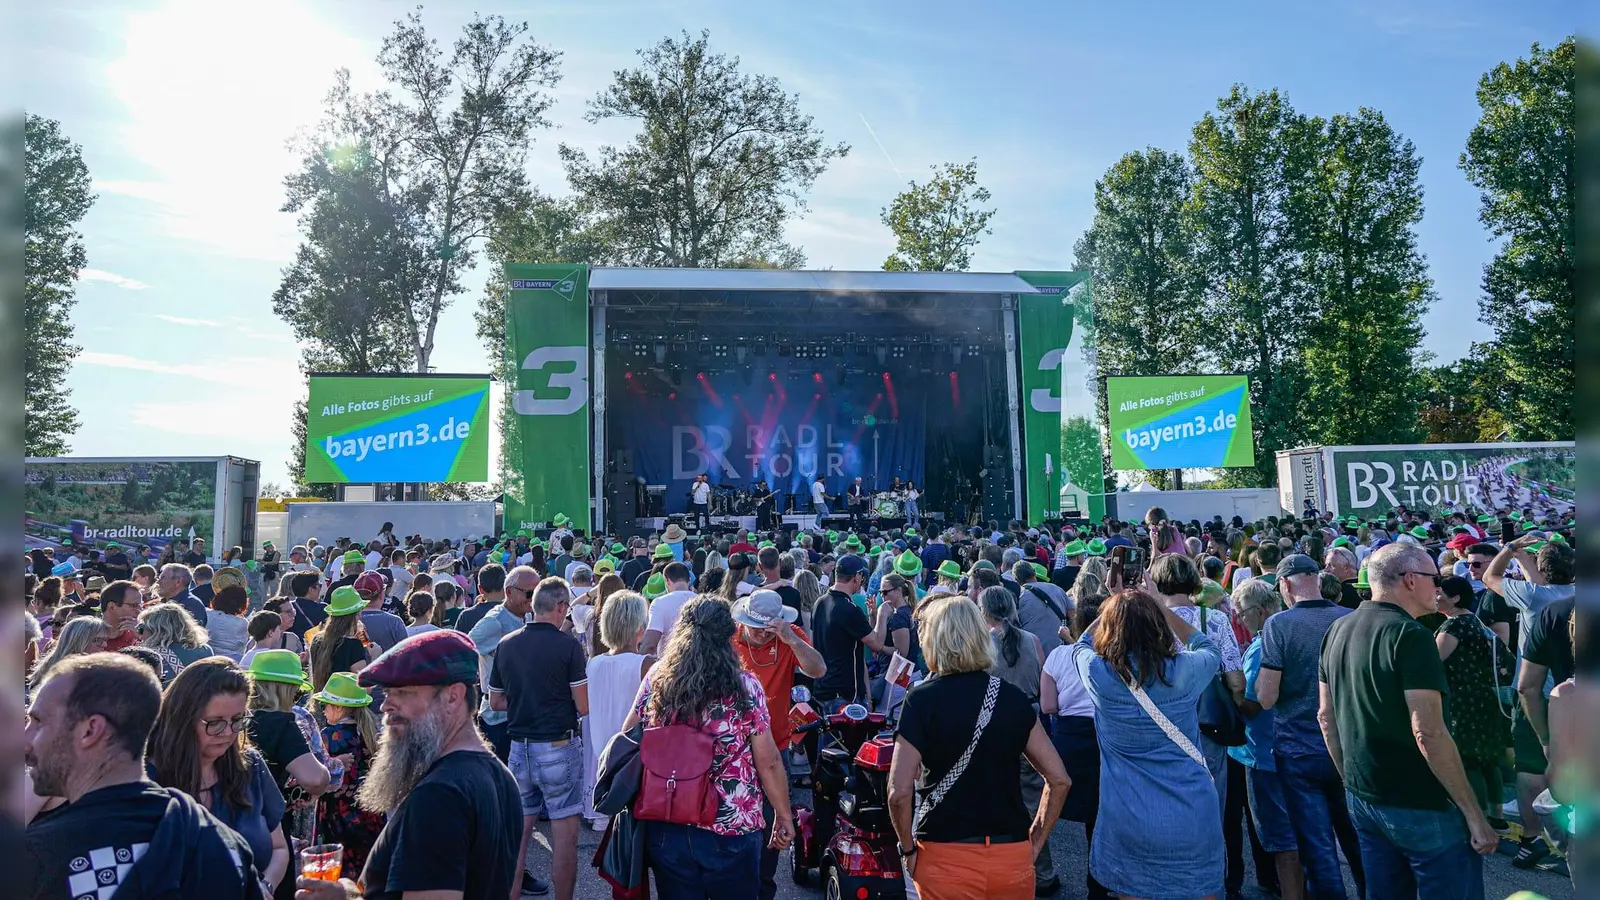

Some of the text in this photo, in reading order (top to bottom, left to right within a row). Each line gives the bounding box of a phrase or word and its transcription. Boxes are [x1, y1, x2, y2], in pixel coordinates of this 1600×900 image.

[560, 280, 575, 292] 3
[512, 346, 589, 415] 3
[321, 405, 345, 417] Alle
[347, 400, 380, 413] Fotos
[382, 392, 411, 410] gibts
[413, 389, 434, 403] auf
[1119, 401, 1138, 412] Alle
[1139, 396, 1165, 407] Fotos
[1165, 389, 1188, 406] gibts
[1190, 386, 1206, 398] auf
[325, 417, 470, 461] bayern3.de
[746, 424, 844, 448] RADL
[1125, 409, 1237, 451] bayern3.de
[672, 424, 741, 480] BR
[745, 453, 845, 478] TOUR
[1402, 459, 1478, 482] RADL
[1347, 461, 1401, 509] BR
[1403, 484, 1480, 507] TOUR
[83, 524, 182, 539] br-radltour.de
